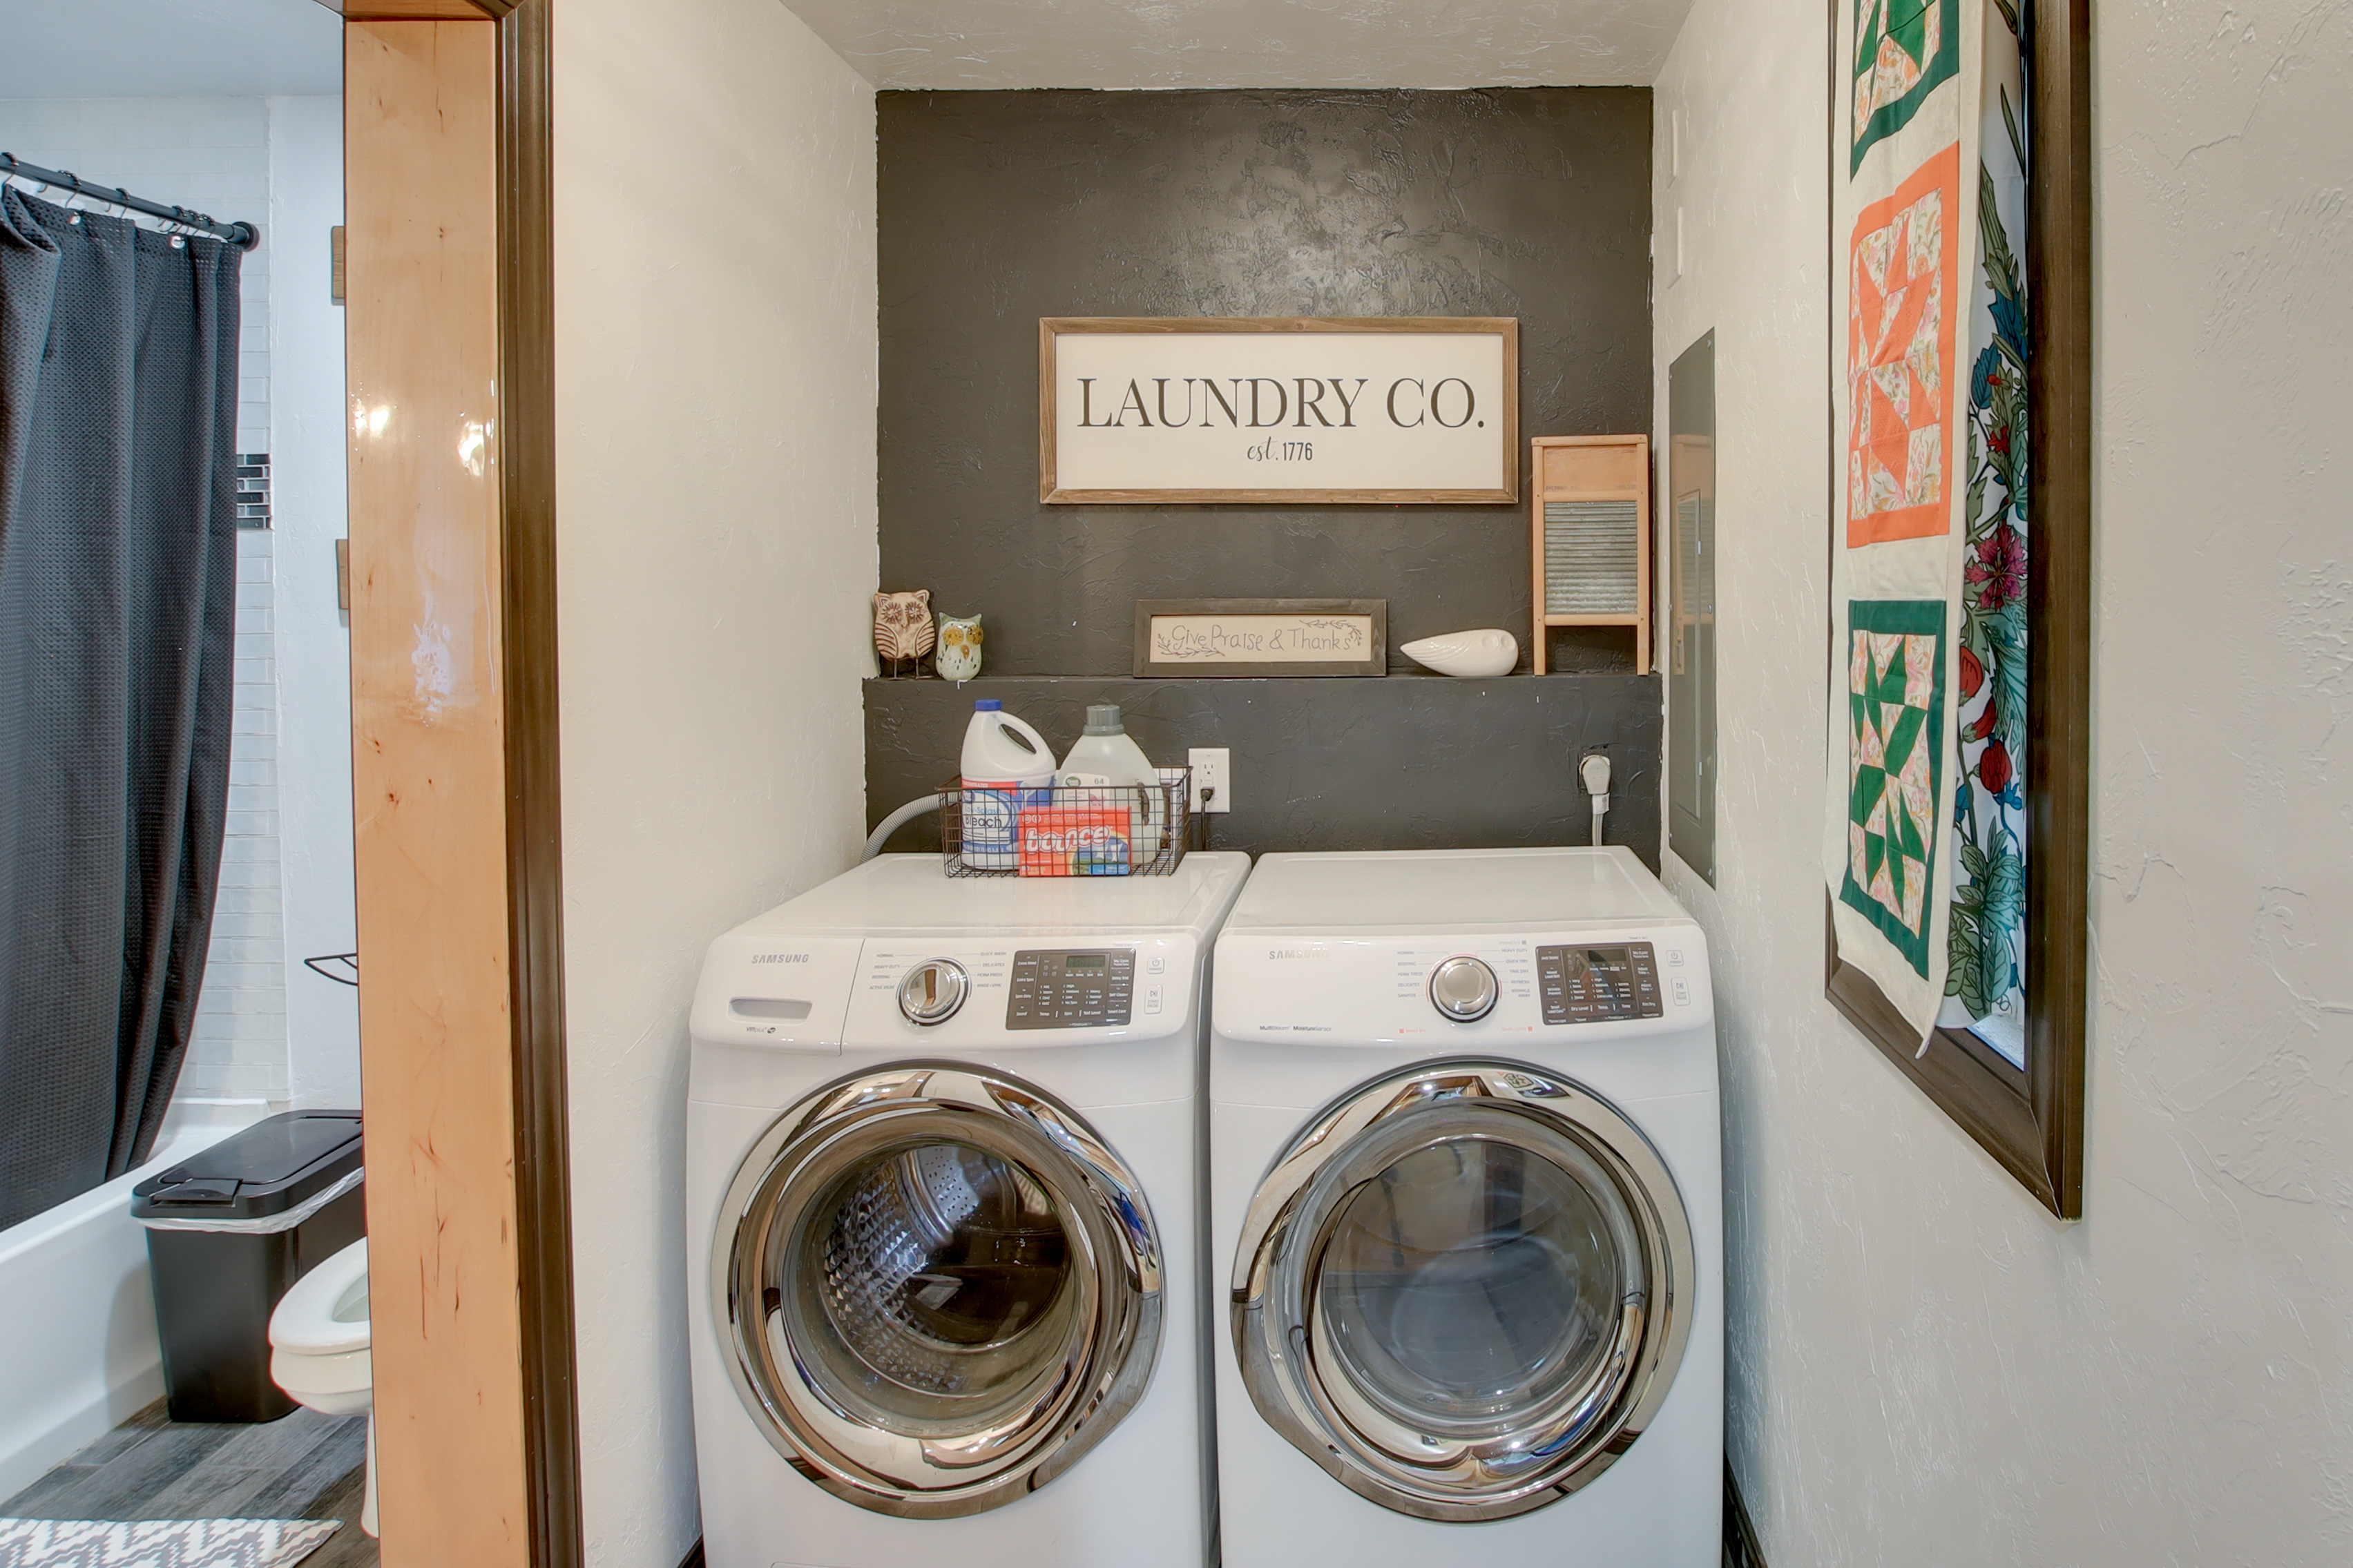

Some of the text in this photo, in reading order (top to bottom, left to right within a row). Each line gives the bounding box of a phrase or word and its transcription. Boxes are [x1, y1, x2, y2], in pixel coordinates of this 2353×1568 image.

[1077, 377, 1485, 429] LAUNDRY CO.
[1247, 436, 1313, 462] est. 1776
[1172, 624, 1352, 651] Give Praise & Thanks
[1025, 825, 1111, 854] bounce
[751, 954, 809, 964] SAMSUNG
[1269, 950, 1329, 960] SAMSUNG
